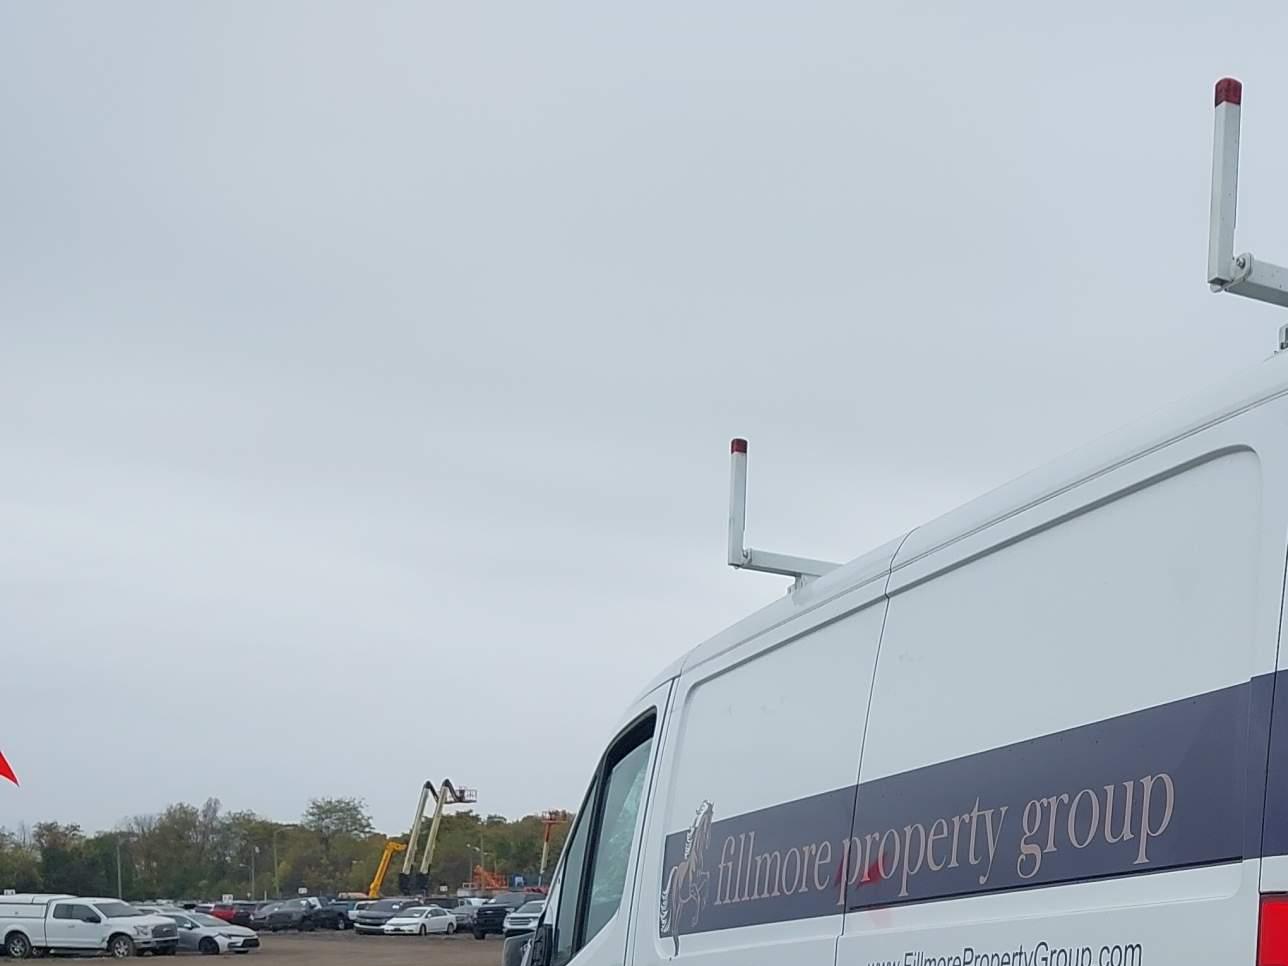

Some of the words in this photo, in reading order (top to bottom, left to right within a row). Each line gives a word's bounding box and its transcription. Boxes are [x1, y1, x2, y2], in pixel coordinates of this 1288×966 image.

[714, 831, 832, 905] fillmore
[836, 797, 1009, 906] property
[1016, 772, 1175, 879] group
